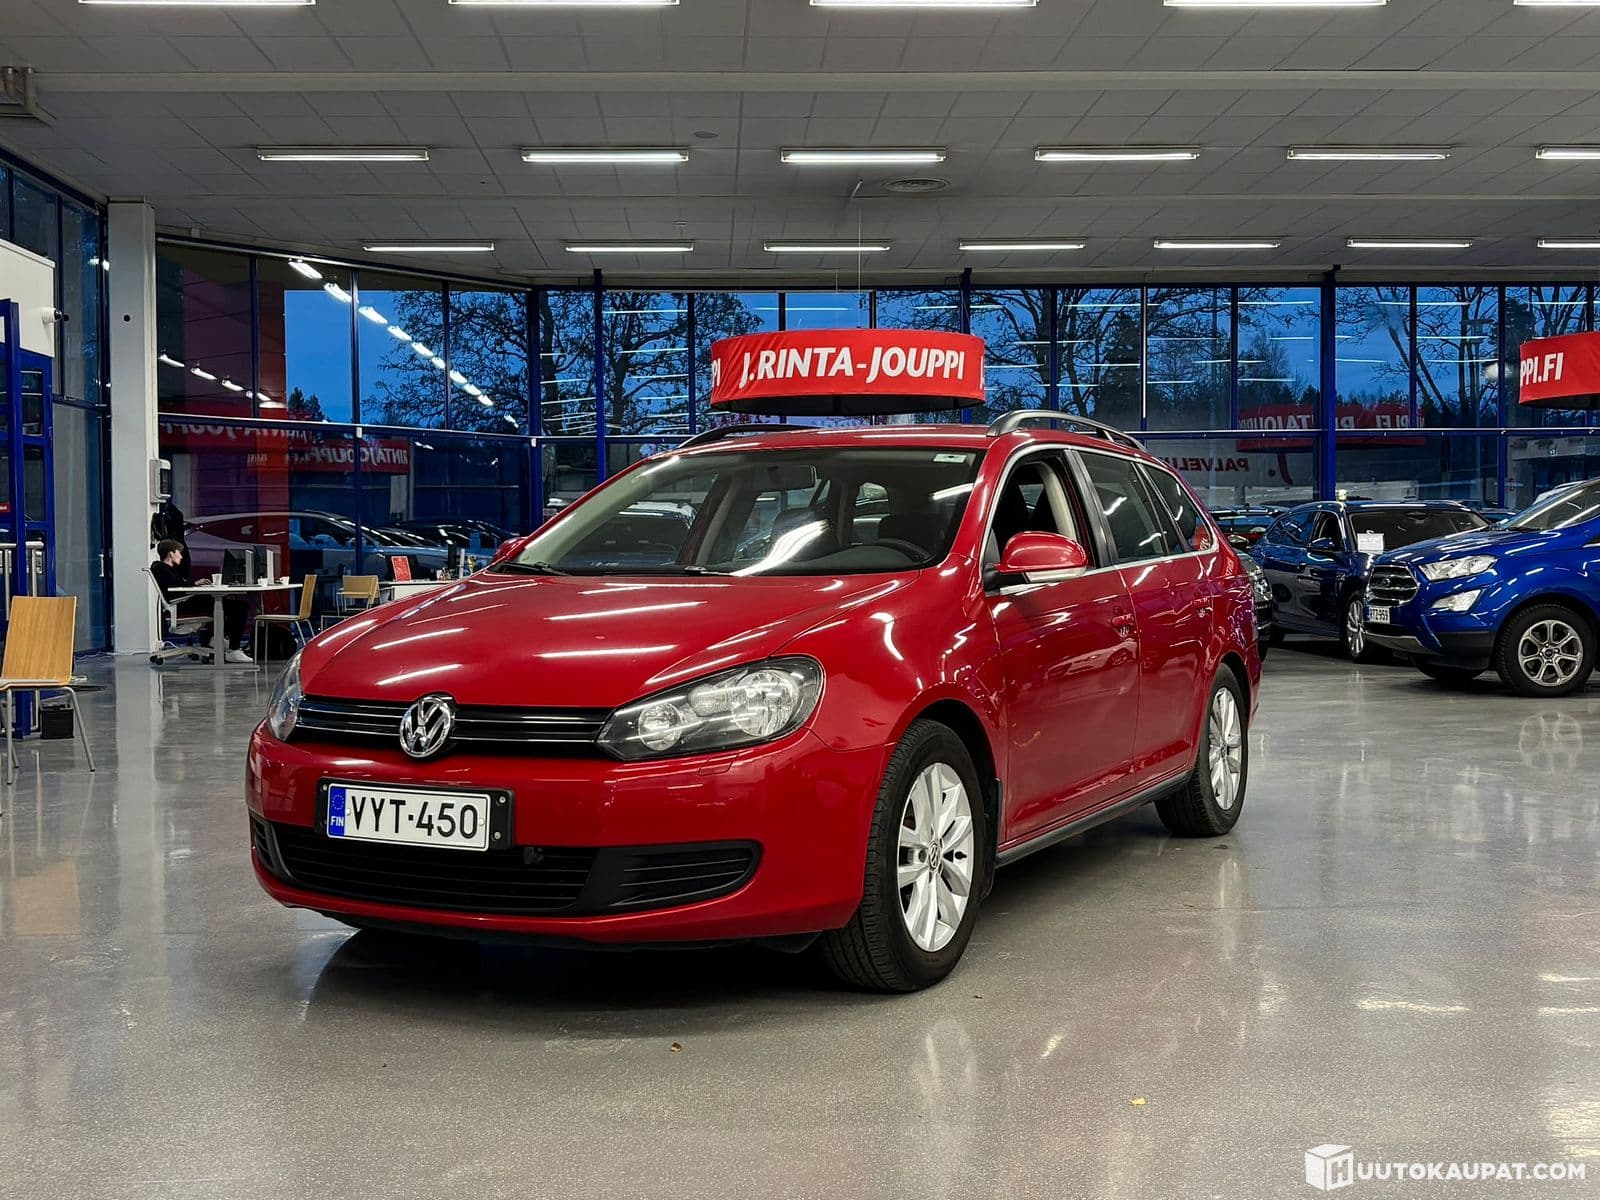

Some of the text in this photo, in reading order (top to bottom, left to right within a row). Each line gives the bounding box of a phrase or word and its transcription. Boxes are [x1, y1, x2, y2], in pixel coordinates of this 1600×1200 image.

[738, 346, 966, 389] J.RINTA-JOUPPI
[330, 816, 344, 827] FIN
[351, 796, 478, 839] VYT-450
